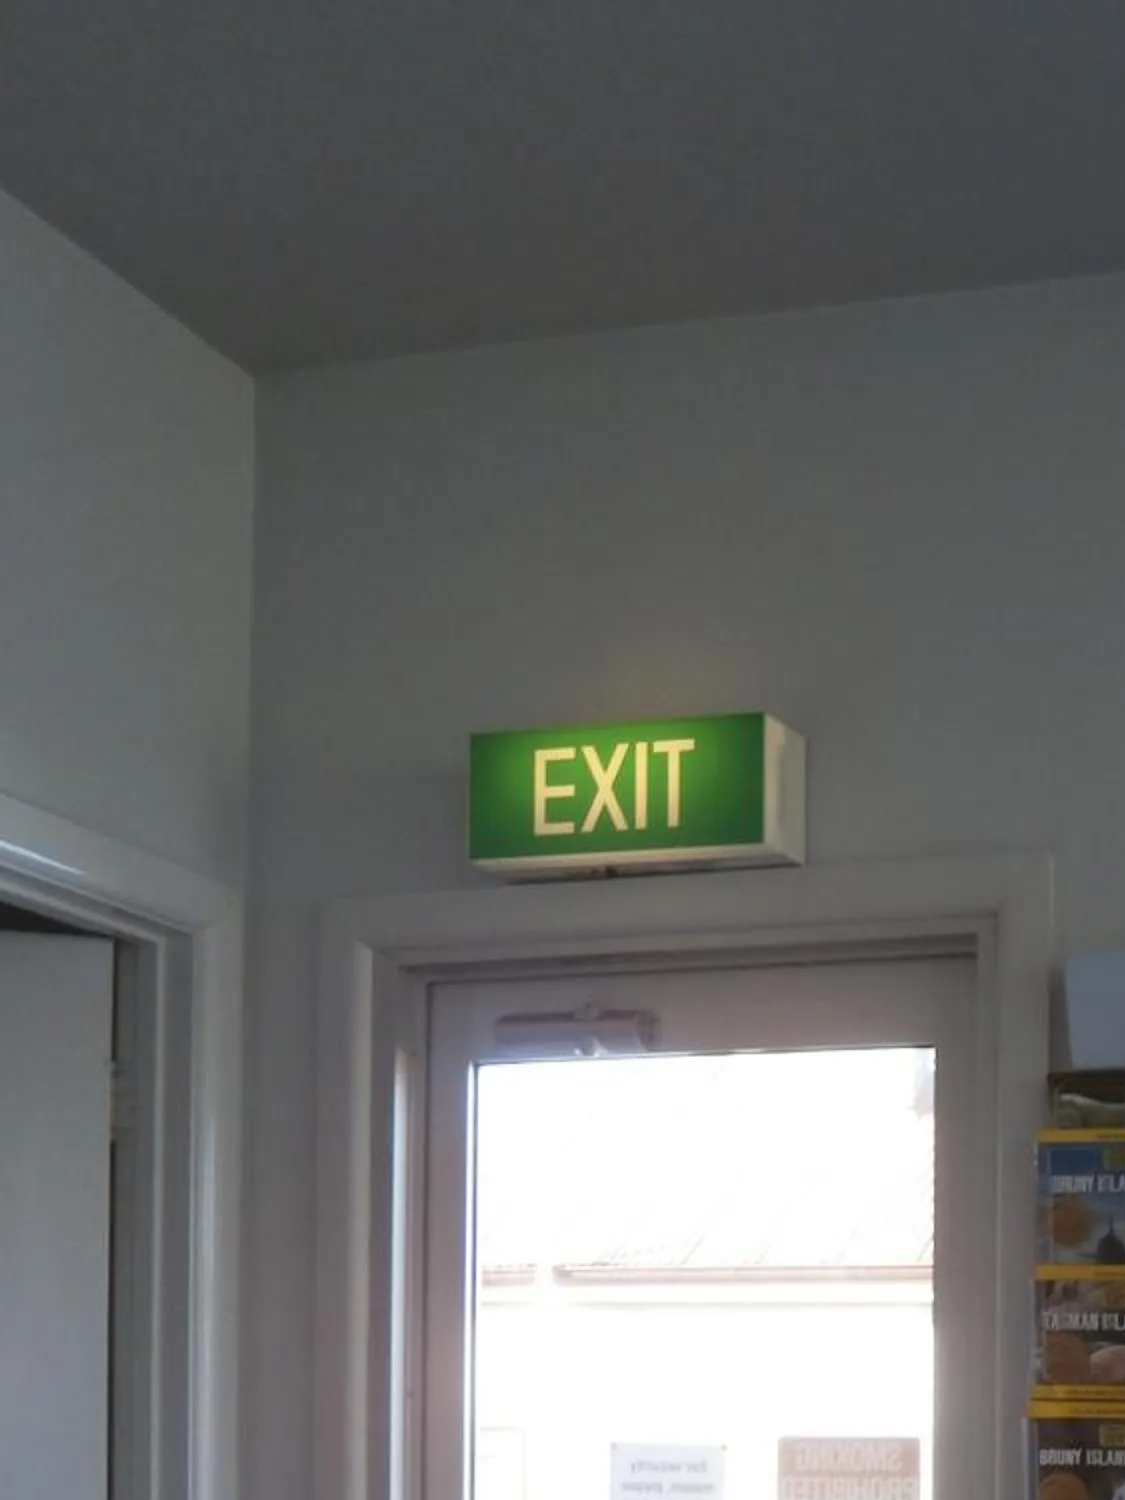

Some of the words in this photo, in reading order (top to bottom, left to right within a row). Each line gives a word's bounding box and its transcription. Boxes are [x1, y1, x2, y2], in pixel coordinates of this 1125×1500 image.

[533, 738, 696, 837] EXIT
[1049, 1174, 1095, 1194] BRUNY
[1042, 1312, 1098, 1332] TASMAN
[1039, 1448, 1083, 1467] BRUNY
